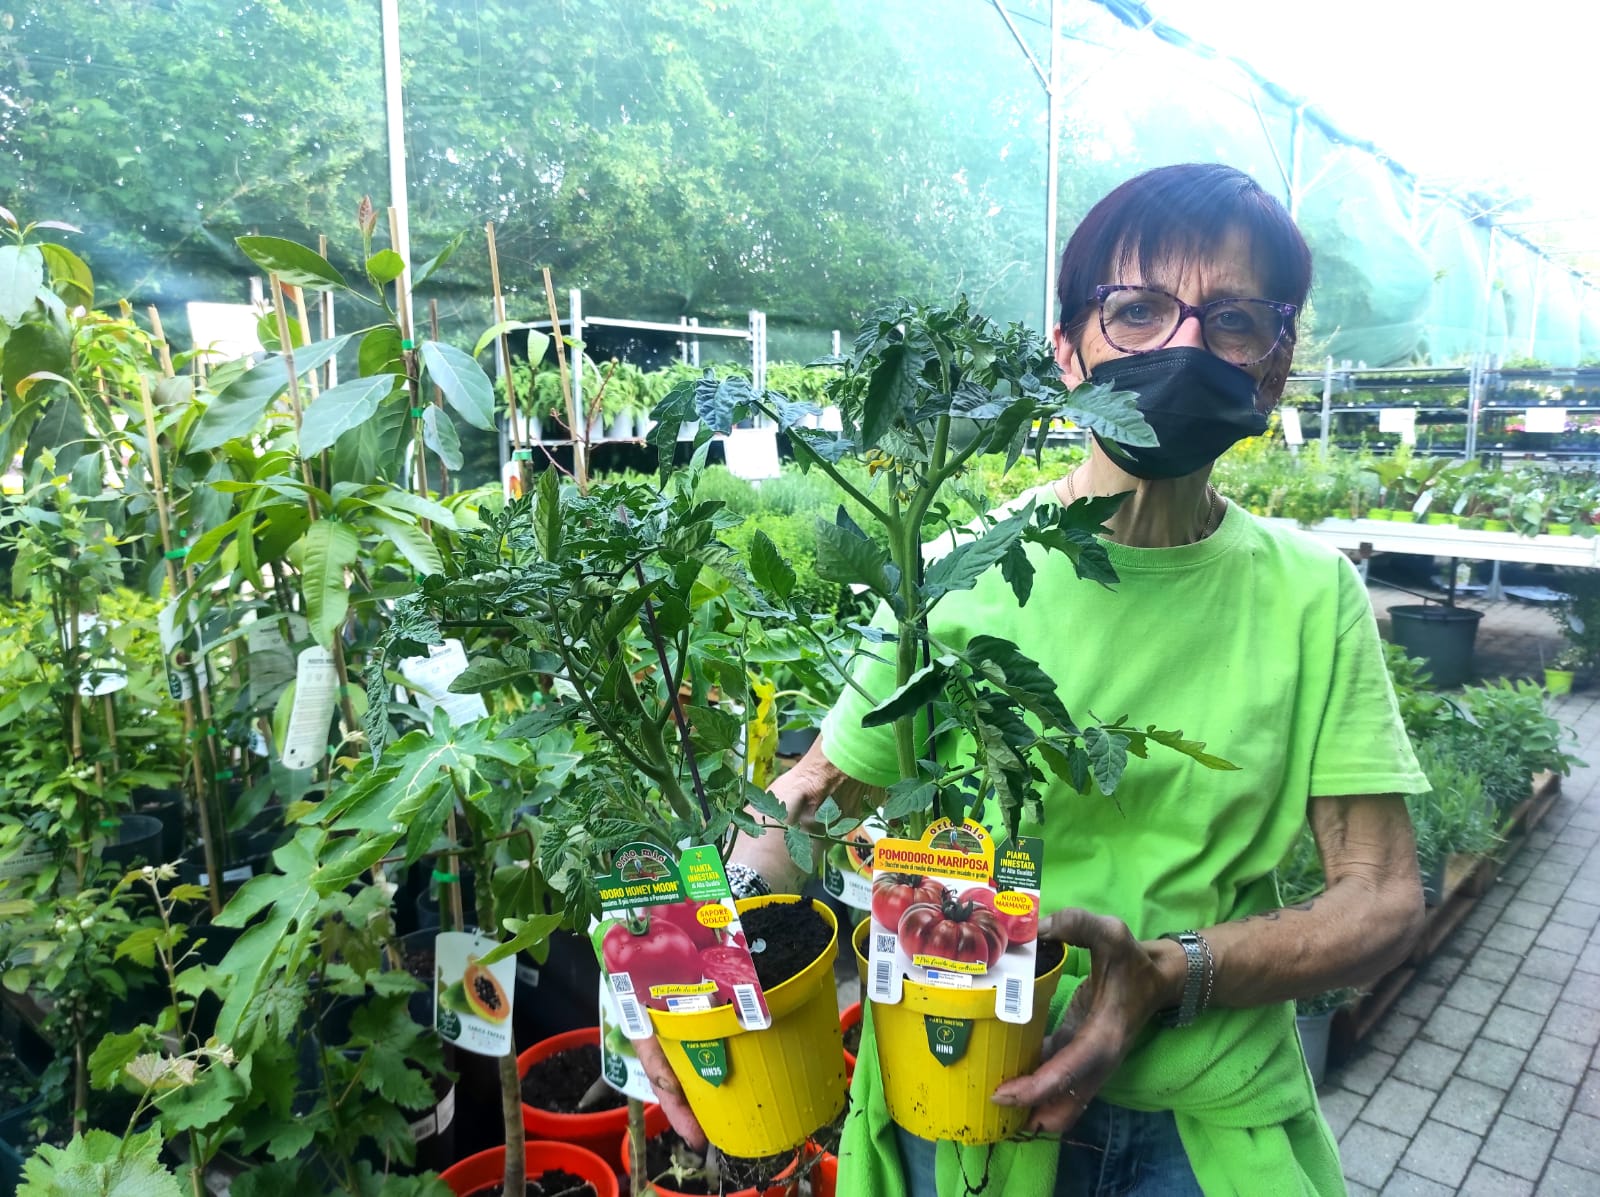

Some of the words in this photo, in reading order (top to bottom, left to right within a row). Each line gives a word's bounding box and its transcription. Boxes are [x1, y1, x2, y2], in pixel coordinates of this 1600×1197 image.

[963, 823, 985, 840] mio
[878, 848, 935, 865] POMODORO
[937, 854, 989, 872] MARIPOSA
[1006, 850, 1030, 861] PIANTA
[689, 863, 713, 874] PIANTA
[1000, 858, 1035, 871] INNESTATA
[687, 871, 720, 883] INNESTATA
[625, 884, 651, 896] HONEY
[1001, 894, 1027, 904] NUOVO
[996, 900, 1031, 911] MARMANDE
[700, 908, 729, 918] SAPORE
